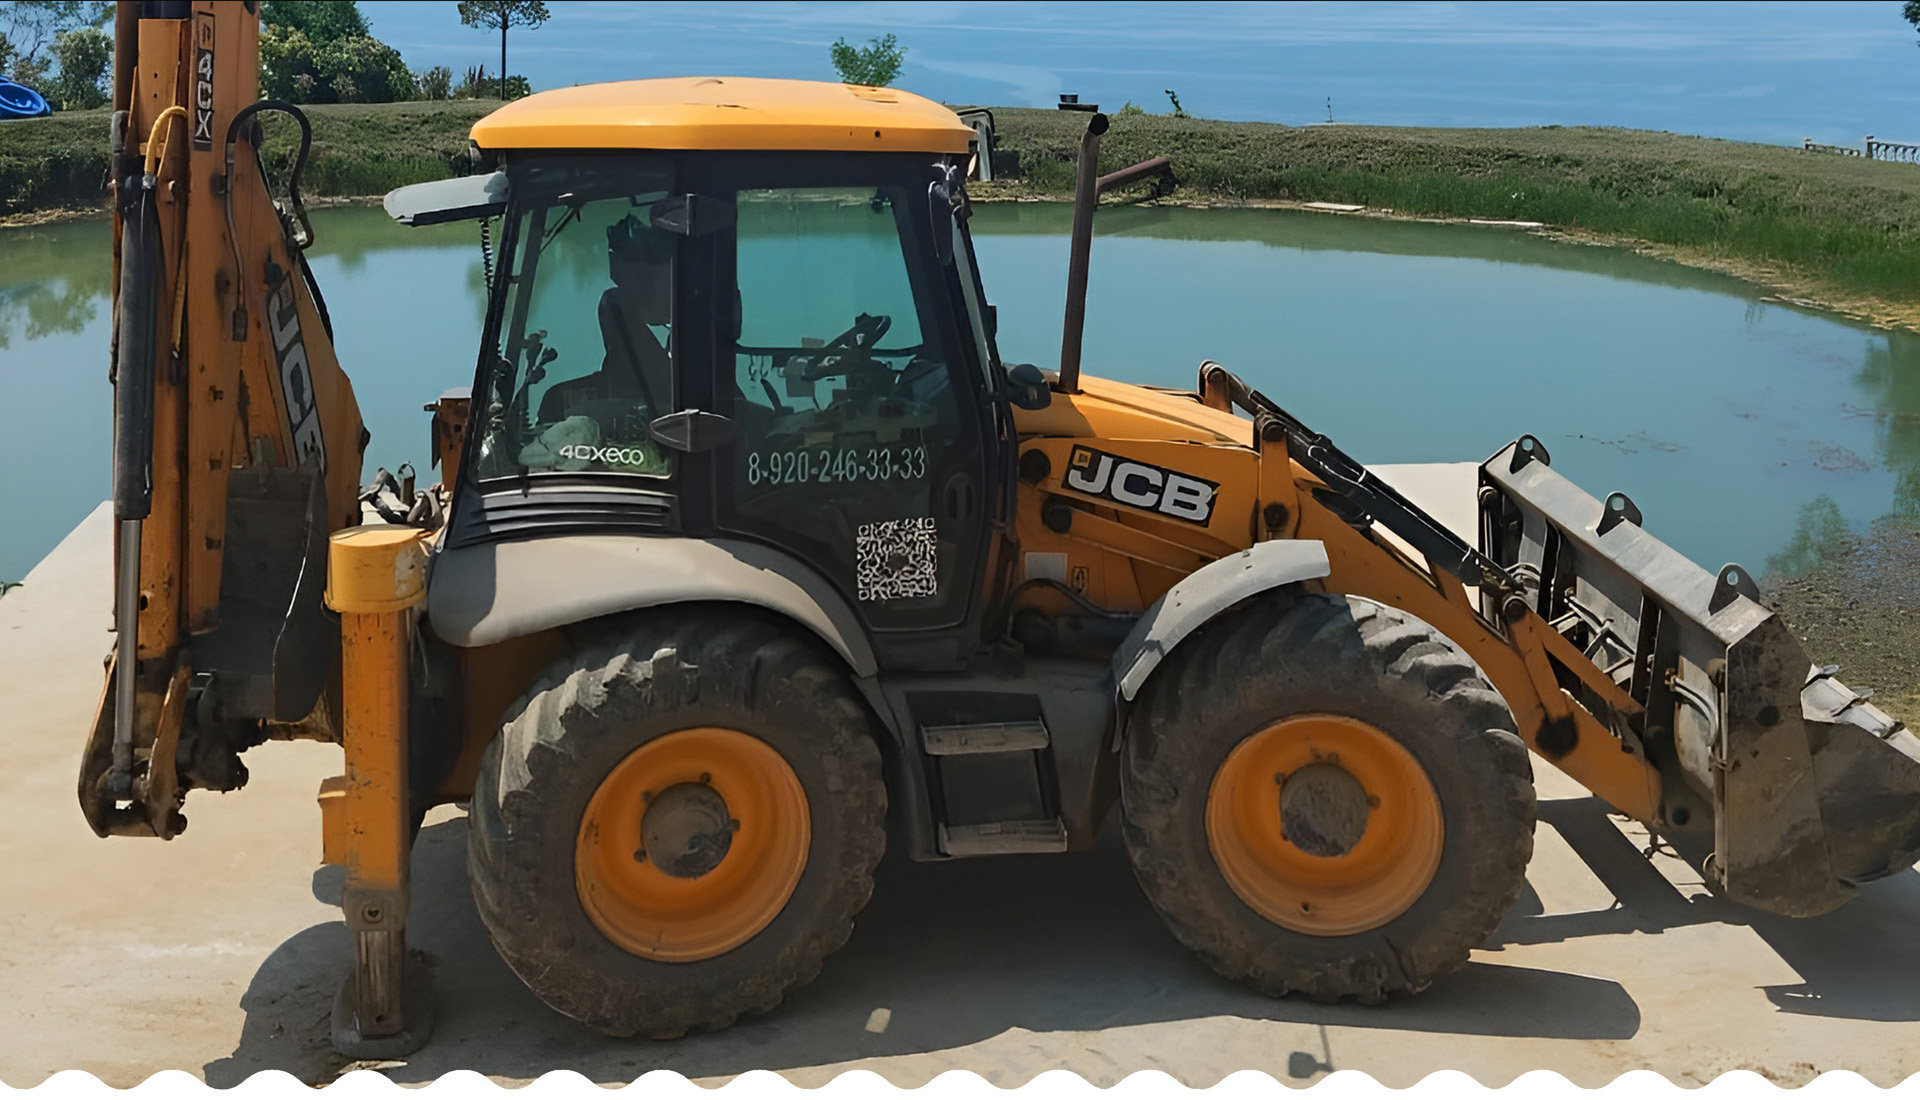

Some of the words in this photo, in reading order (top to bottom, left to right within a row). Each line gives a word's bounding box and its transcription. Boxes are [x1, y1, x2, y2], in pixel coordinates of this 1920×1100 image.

[194, 52, 213, 139] 4CX
[748, 447, 926, 485] 8-920-246-33-33
[1068, 455, 1213, 521] JCB
